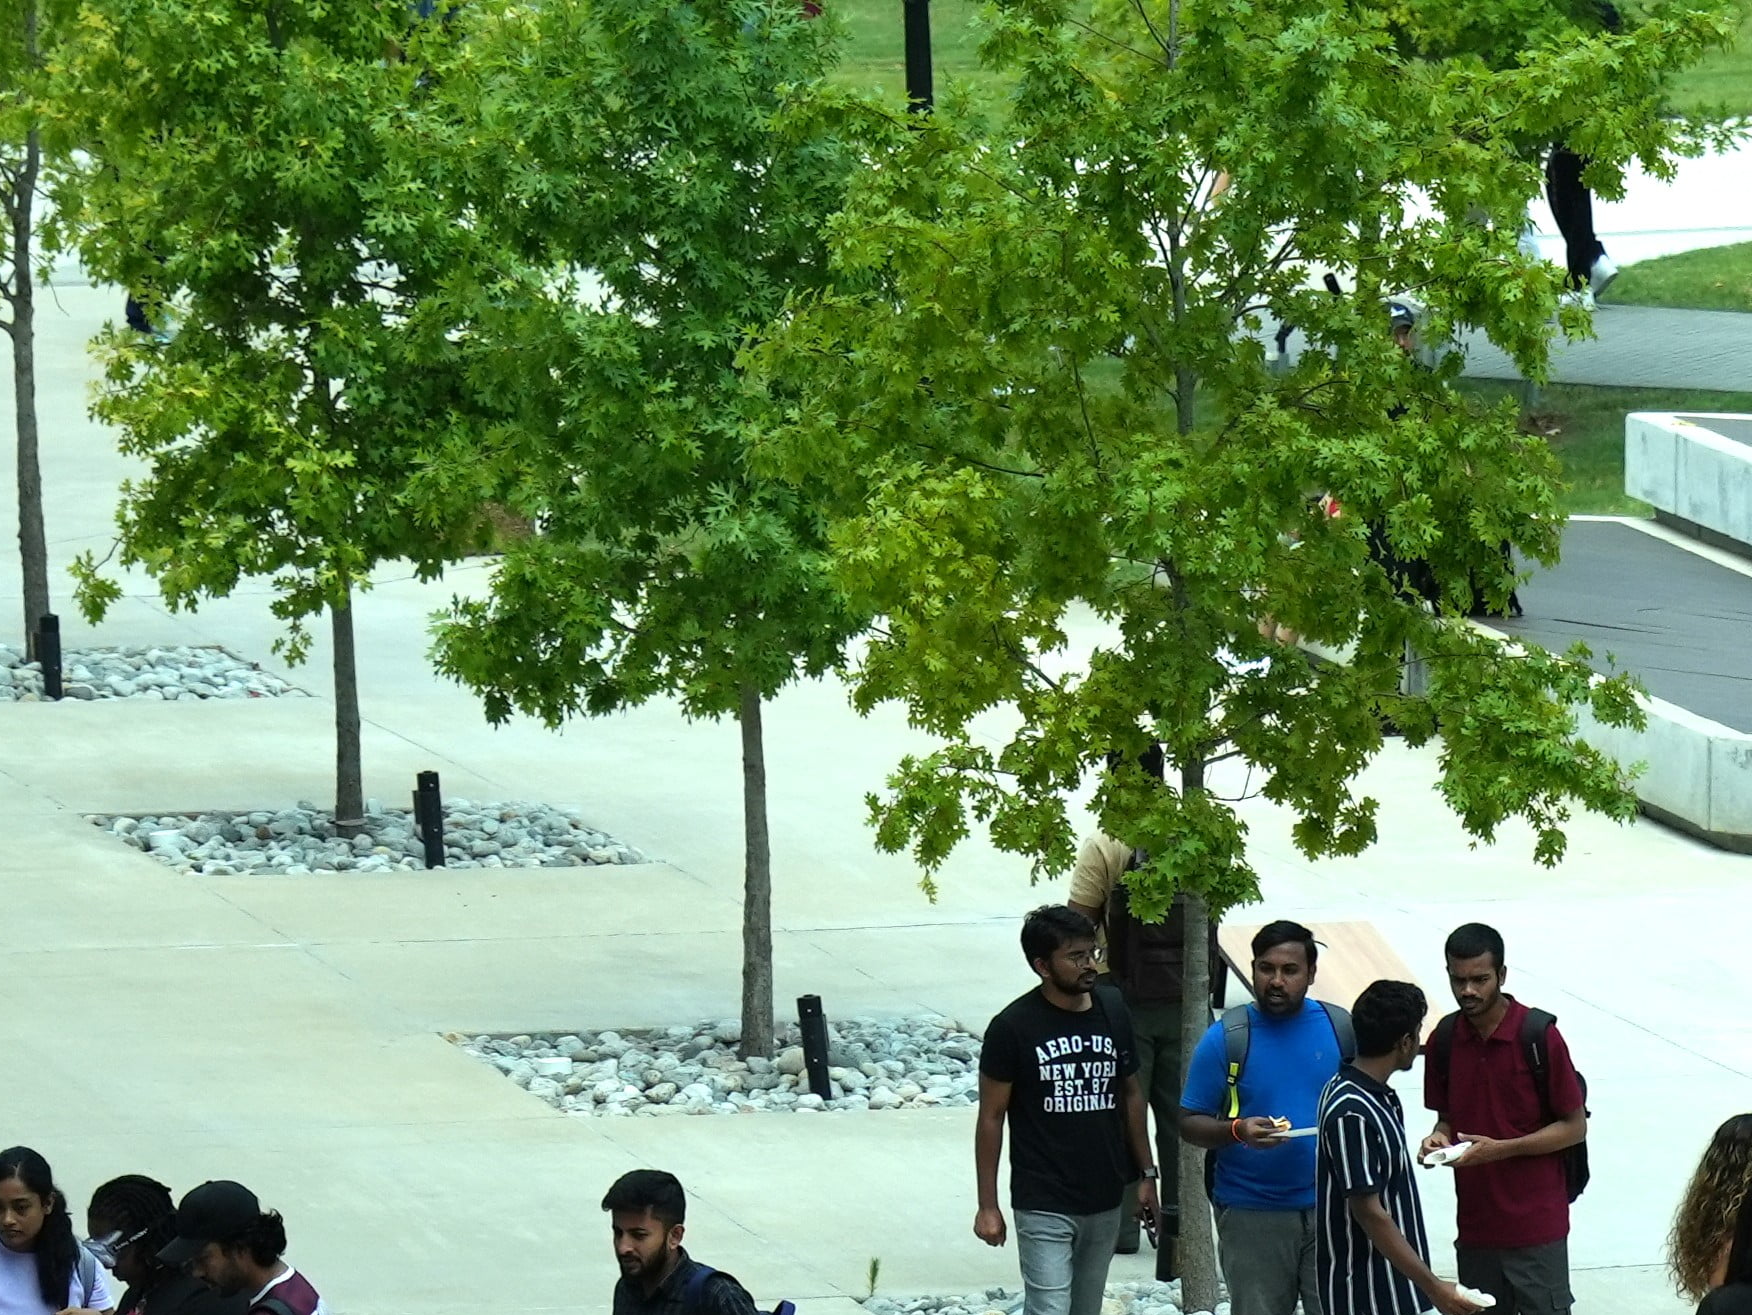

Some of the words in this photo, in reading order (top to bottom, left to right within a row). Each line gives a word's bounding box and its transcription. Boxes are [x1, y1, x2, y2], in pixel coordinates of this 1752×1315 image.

[1039, 1063, 1076, 1081] NEW
[1054, 1079, 1088, 1096] EST.
[1092, 1078, 1109, 1094] 87
[1043, 1094, 1116, 1113] ORIGINAL
